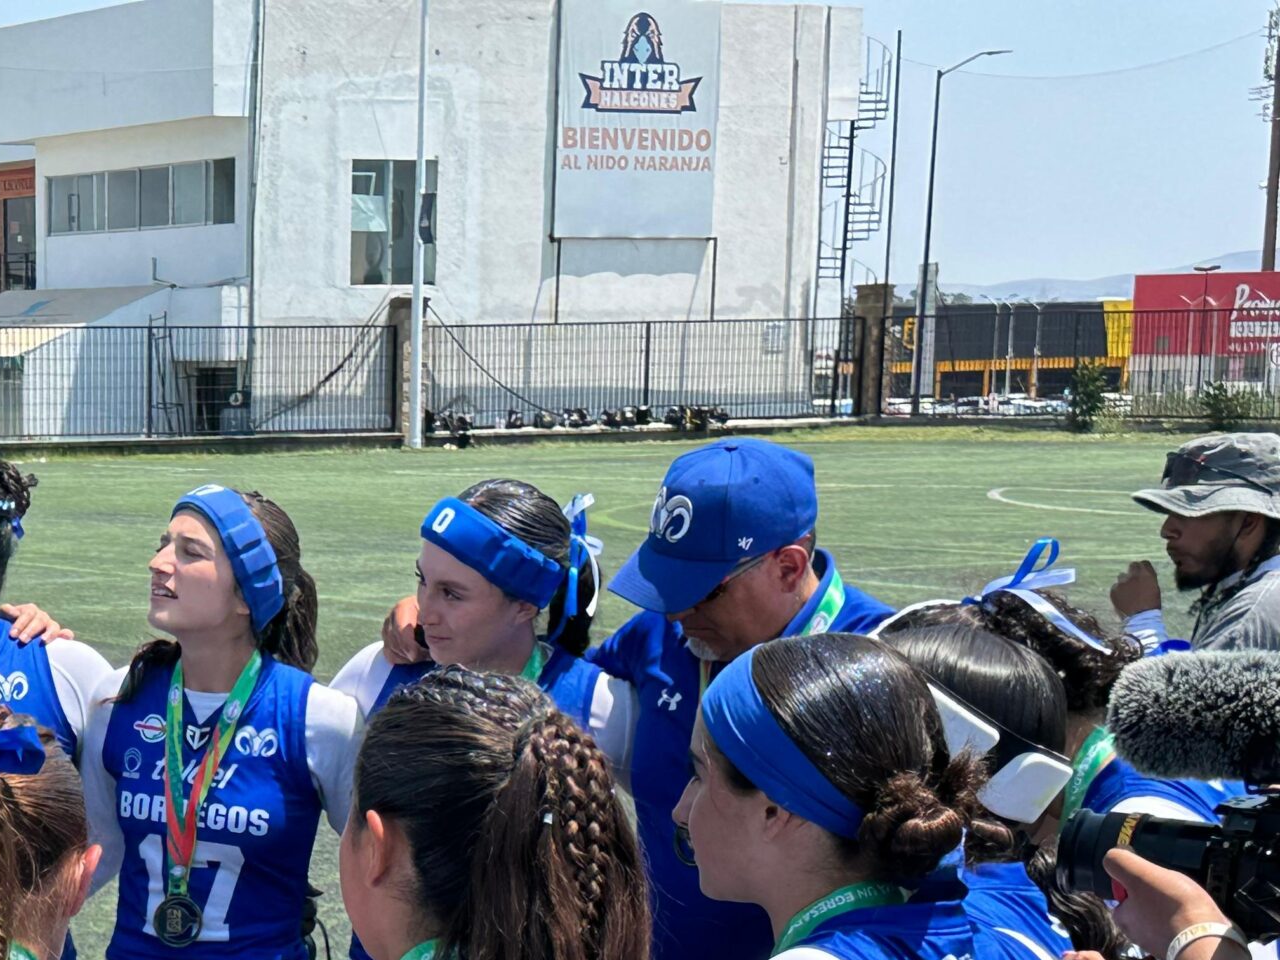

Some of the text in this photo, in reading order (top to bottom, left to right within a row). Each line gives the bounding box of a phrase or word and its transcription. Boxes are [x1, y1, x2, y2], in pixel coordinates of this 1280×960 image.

[602, 61, 680, 91] INTER
[600, 90, 678, 109] HALCONES
[562, 127, 712, 152] BIENVENIDO
[561, 154, 712, 172] AL NIDO NARANJA
[138, 833, 245, 942] 17
